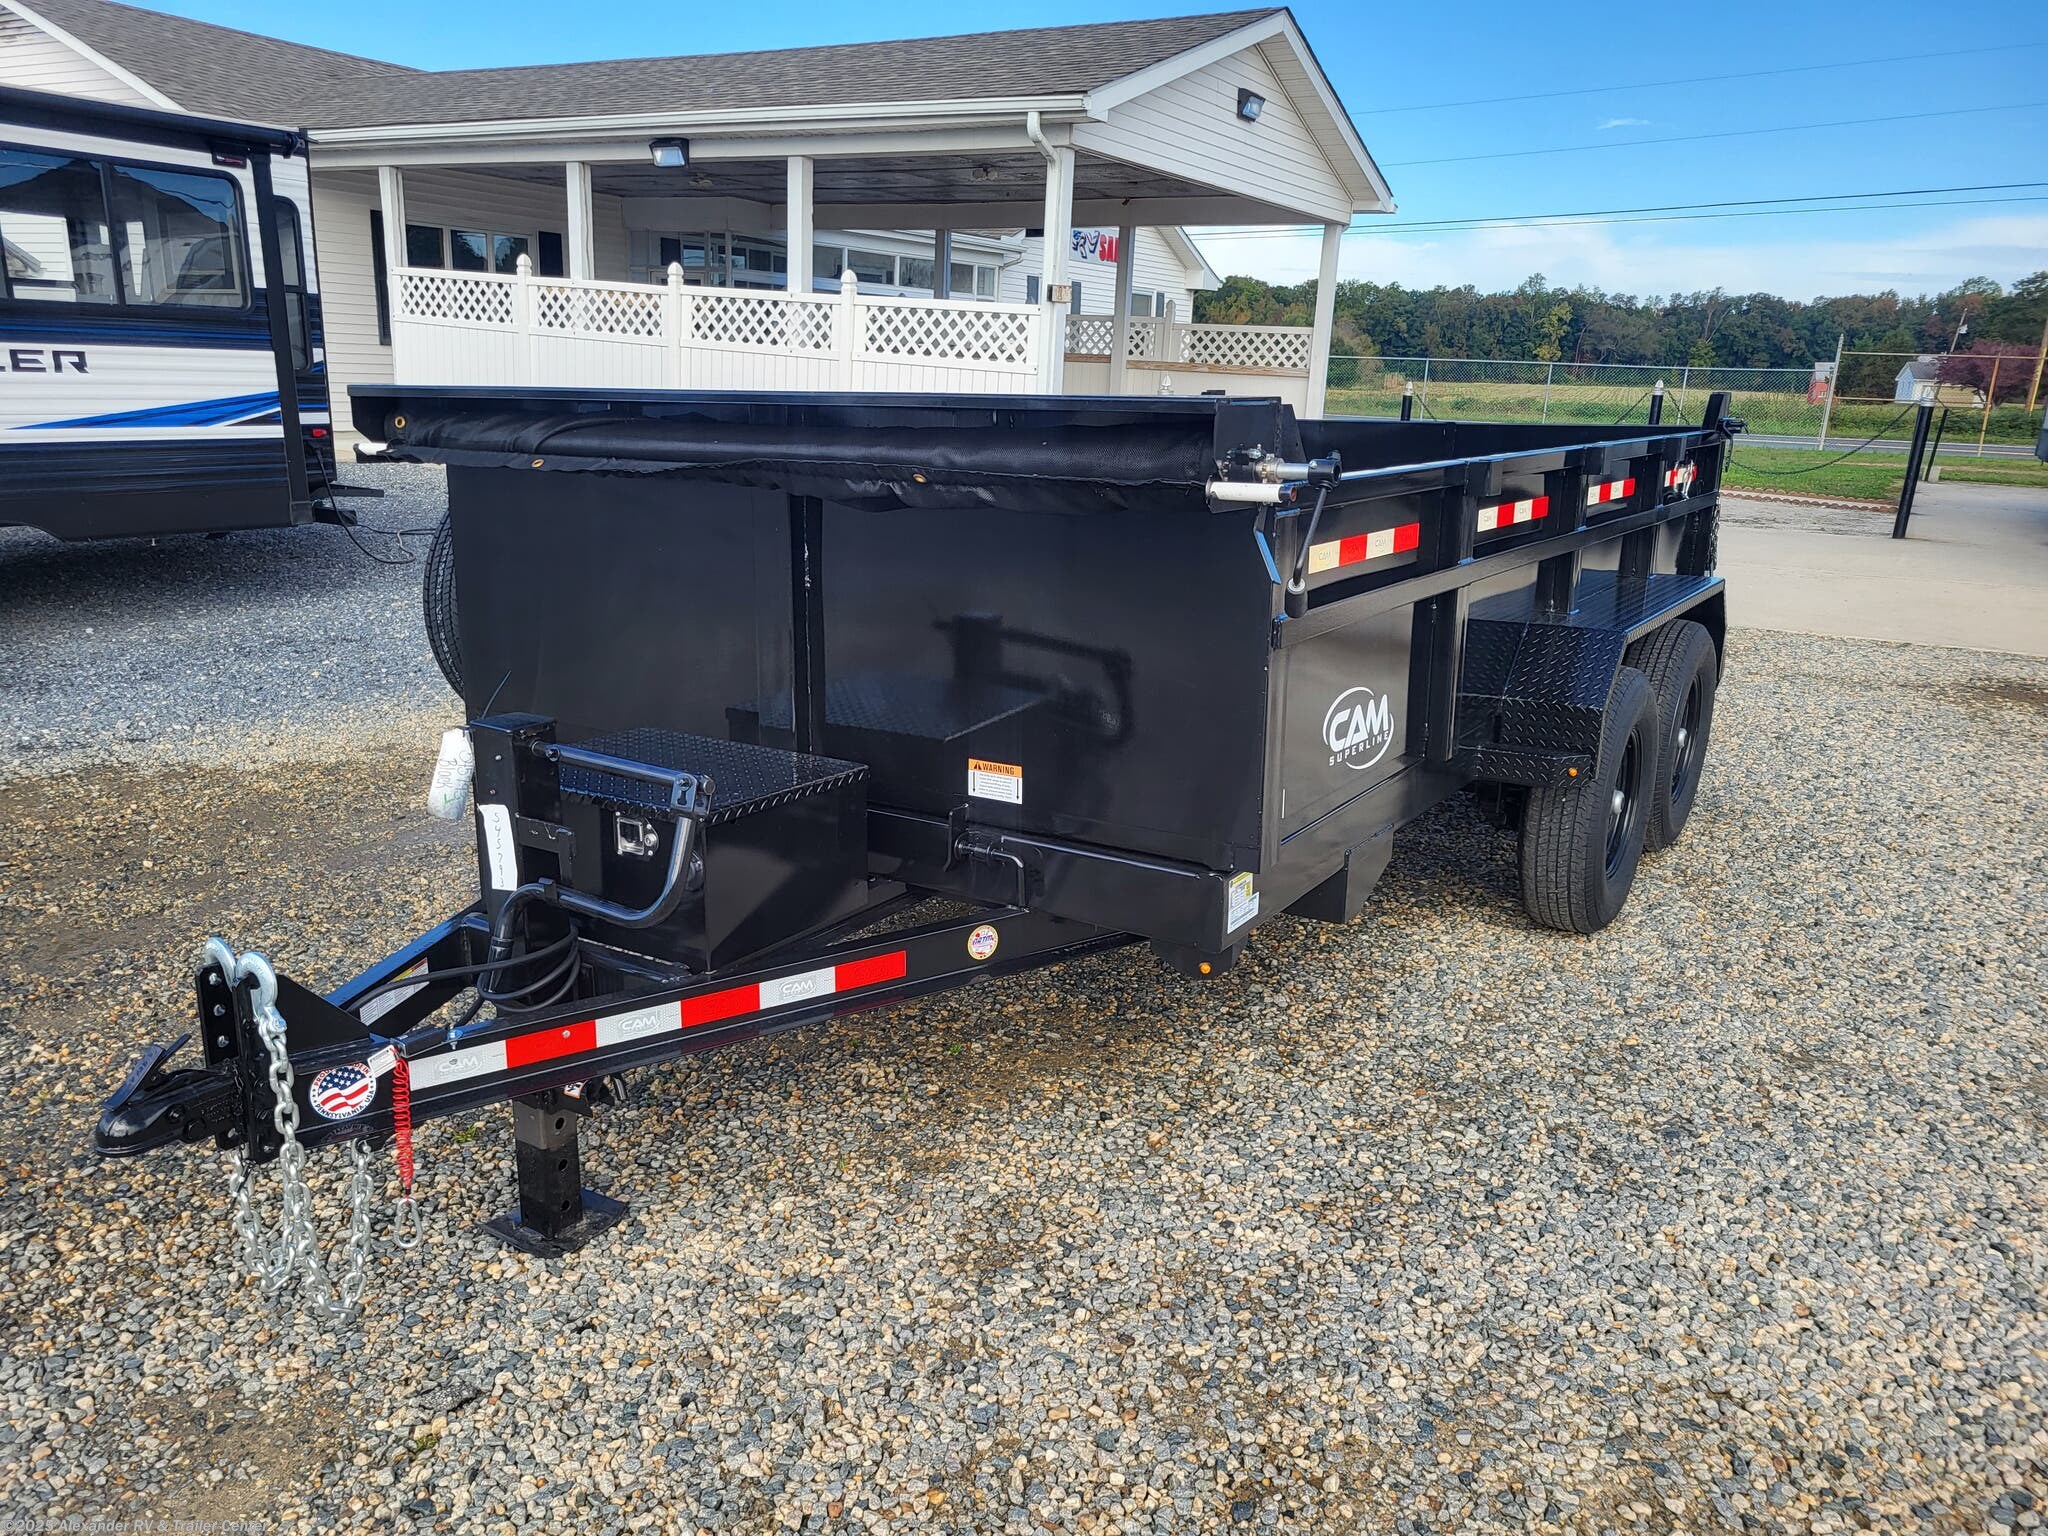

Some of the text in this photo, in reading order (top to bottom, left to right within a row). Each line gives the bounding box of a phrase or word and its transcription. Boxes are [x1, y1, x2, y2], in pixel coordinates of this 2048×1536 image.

[0, 349, 89, 373] ER
[1329, 694, 1389, 752] CAM
[1329, 730, 1389, 766] SUPERLINE
[982, 763, 1015, 775] WARNING
[783, 980, 813, 993] CAM
[622, 1016, 656, 1030] CAM
[365, 1090, 374, 1103] USA
